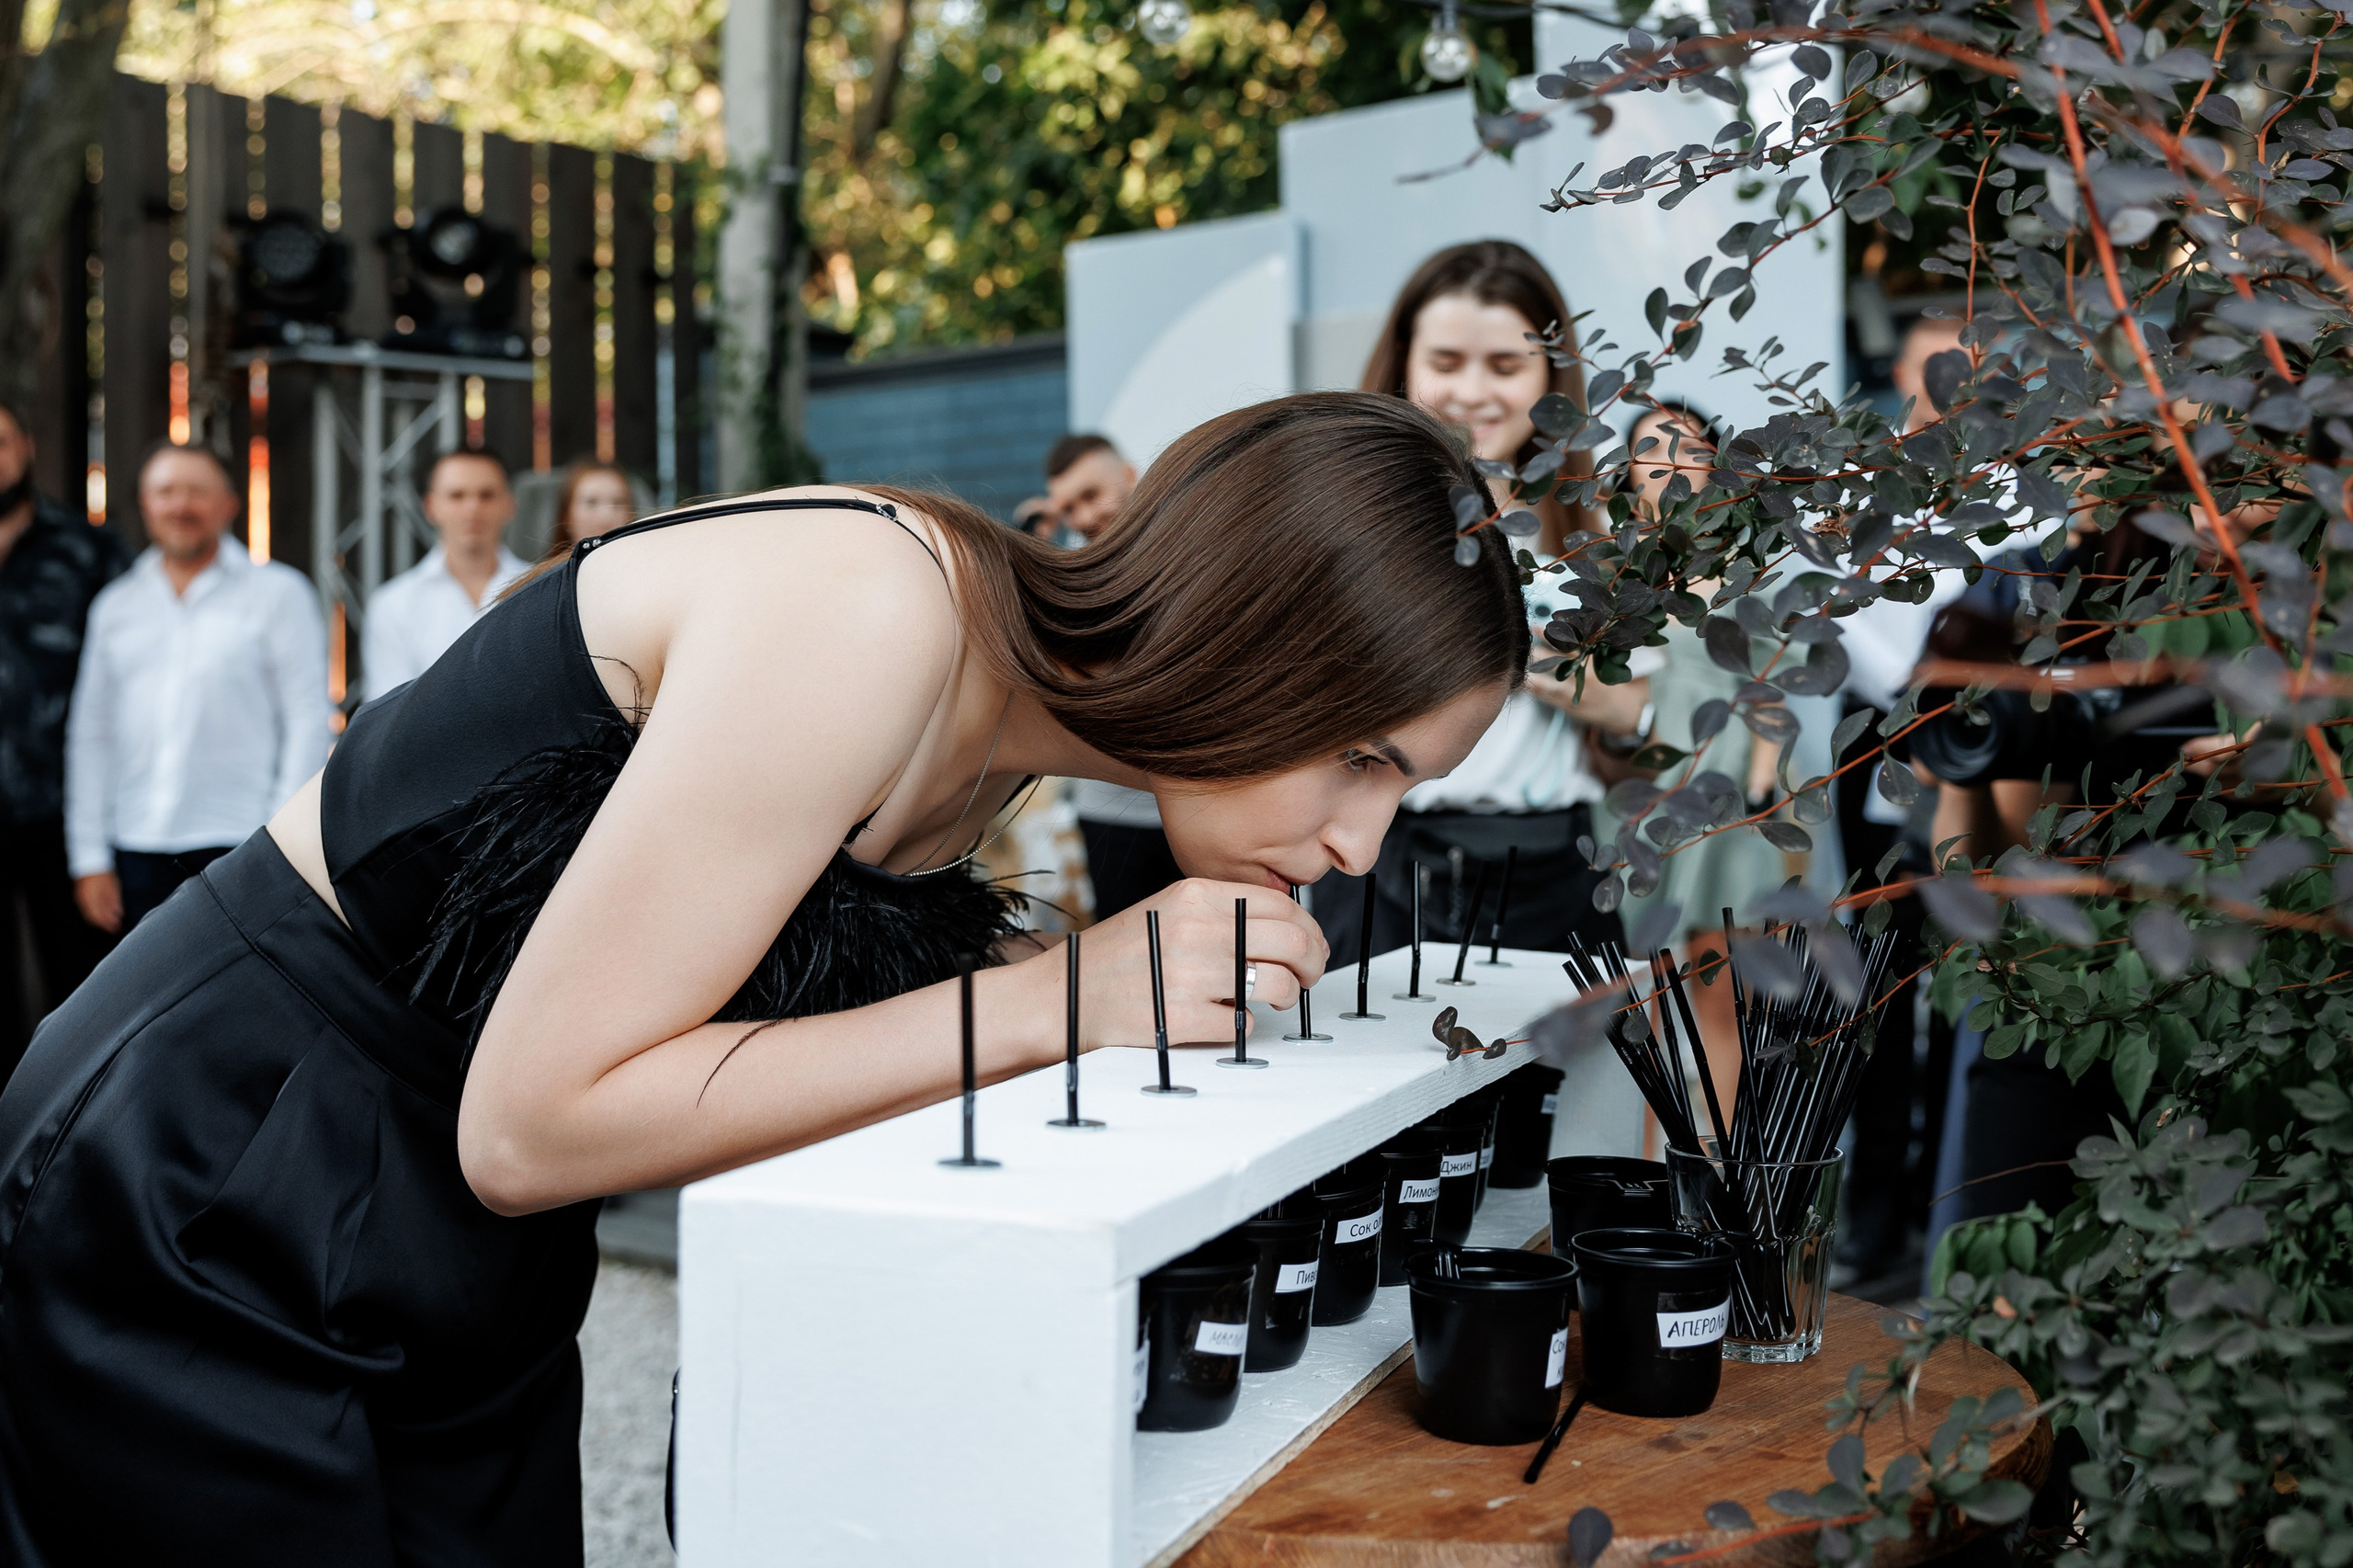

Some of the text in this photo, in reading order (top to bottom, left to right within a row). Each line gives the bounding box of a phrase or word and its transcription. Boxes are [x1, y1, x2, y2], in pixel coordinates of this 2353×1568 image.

[1440, 1160, 1472, 1176] Джин
[1350, 1222, 1371, 1237] Сок
[1296, 1270, 1316, 1285] Пив
[1666, 1312, 1725, 1338] АПЕРОЛЬ
